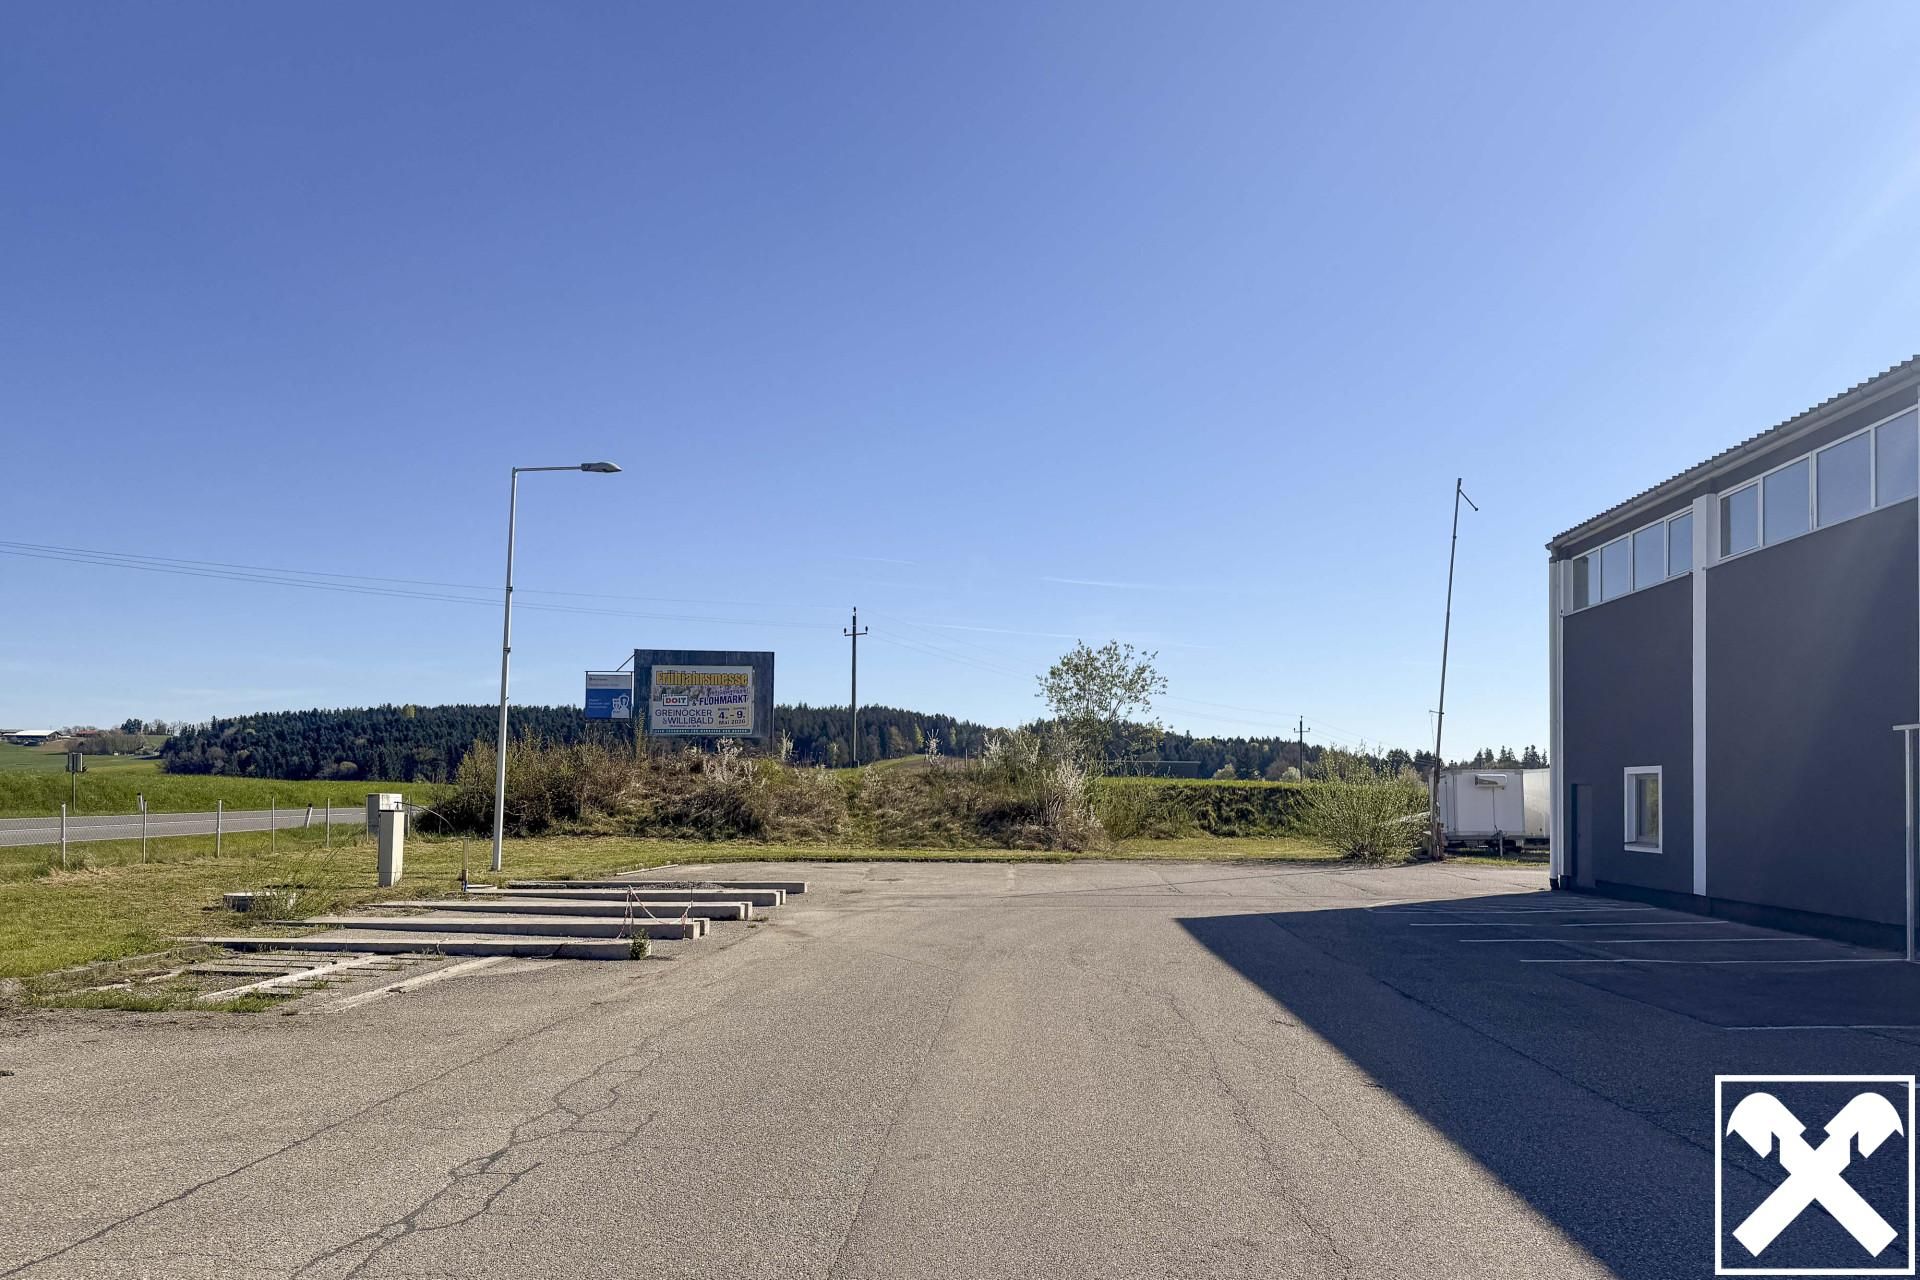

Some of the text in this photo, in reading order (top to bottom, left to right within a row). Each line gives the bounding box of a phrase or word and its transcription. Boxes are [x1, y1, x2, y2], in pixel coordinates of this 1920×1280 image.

[656, 670, 748, 686] Frühjahrsmesse
[699, 695, 748, 706] FLOHMARKT
[718, 711, 728, 719] 4.
